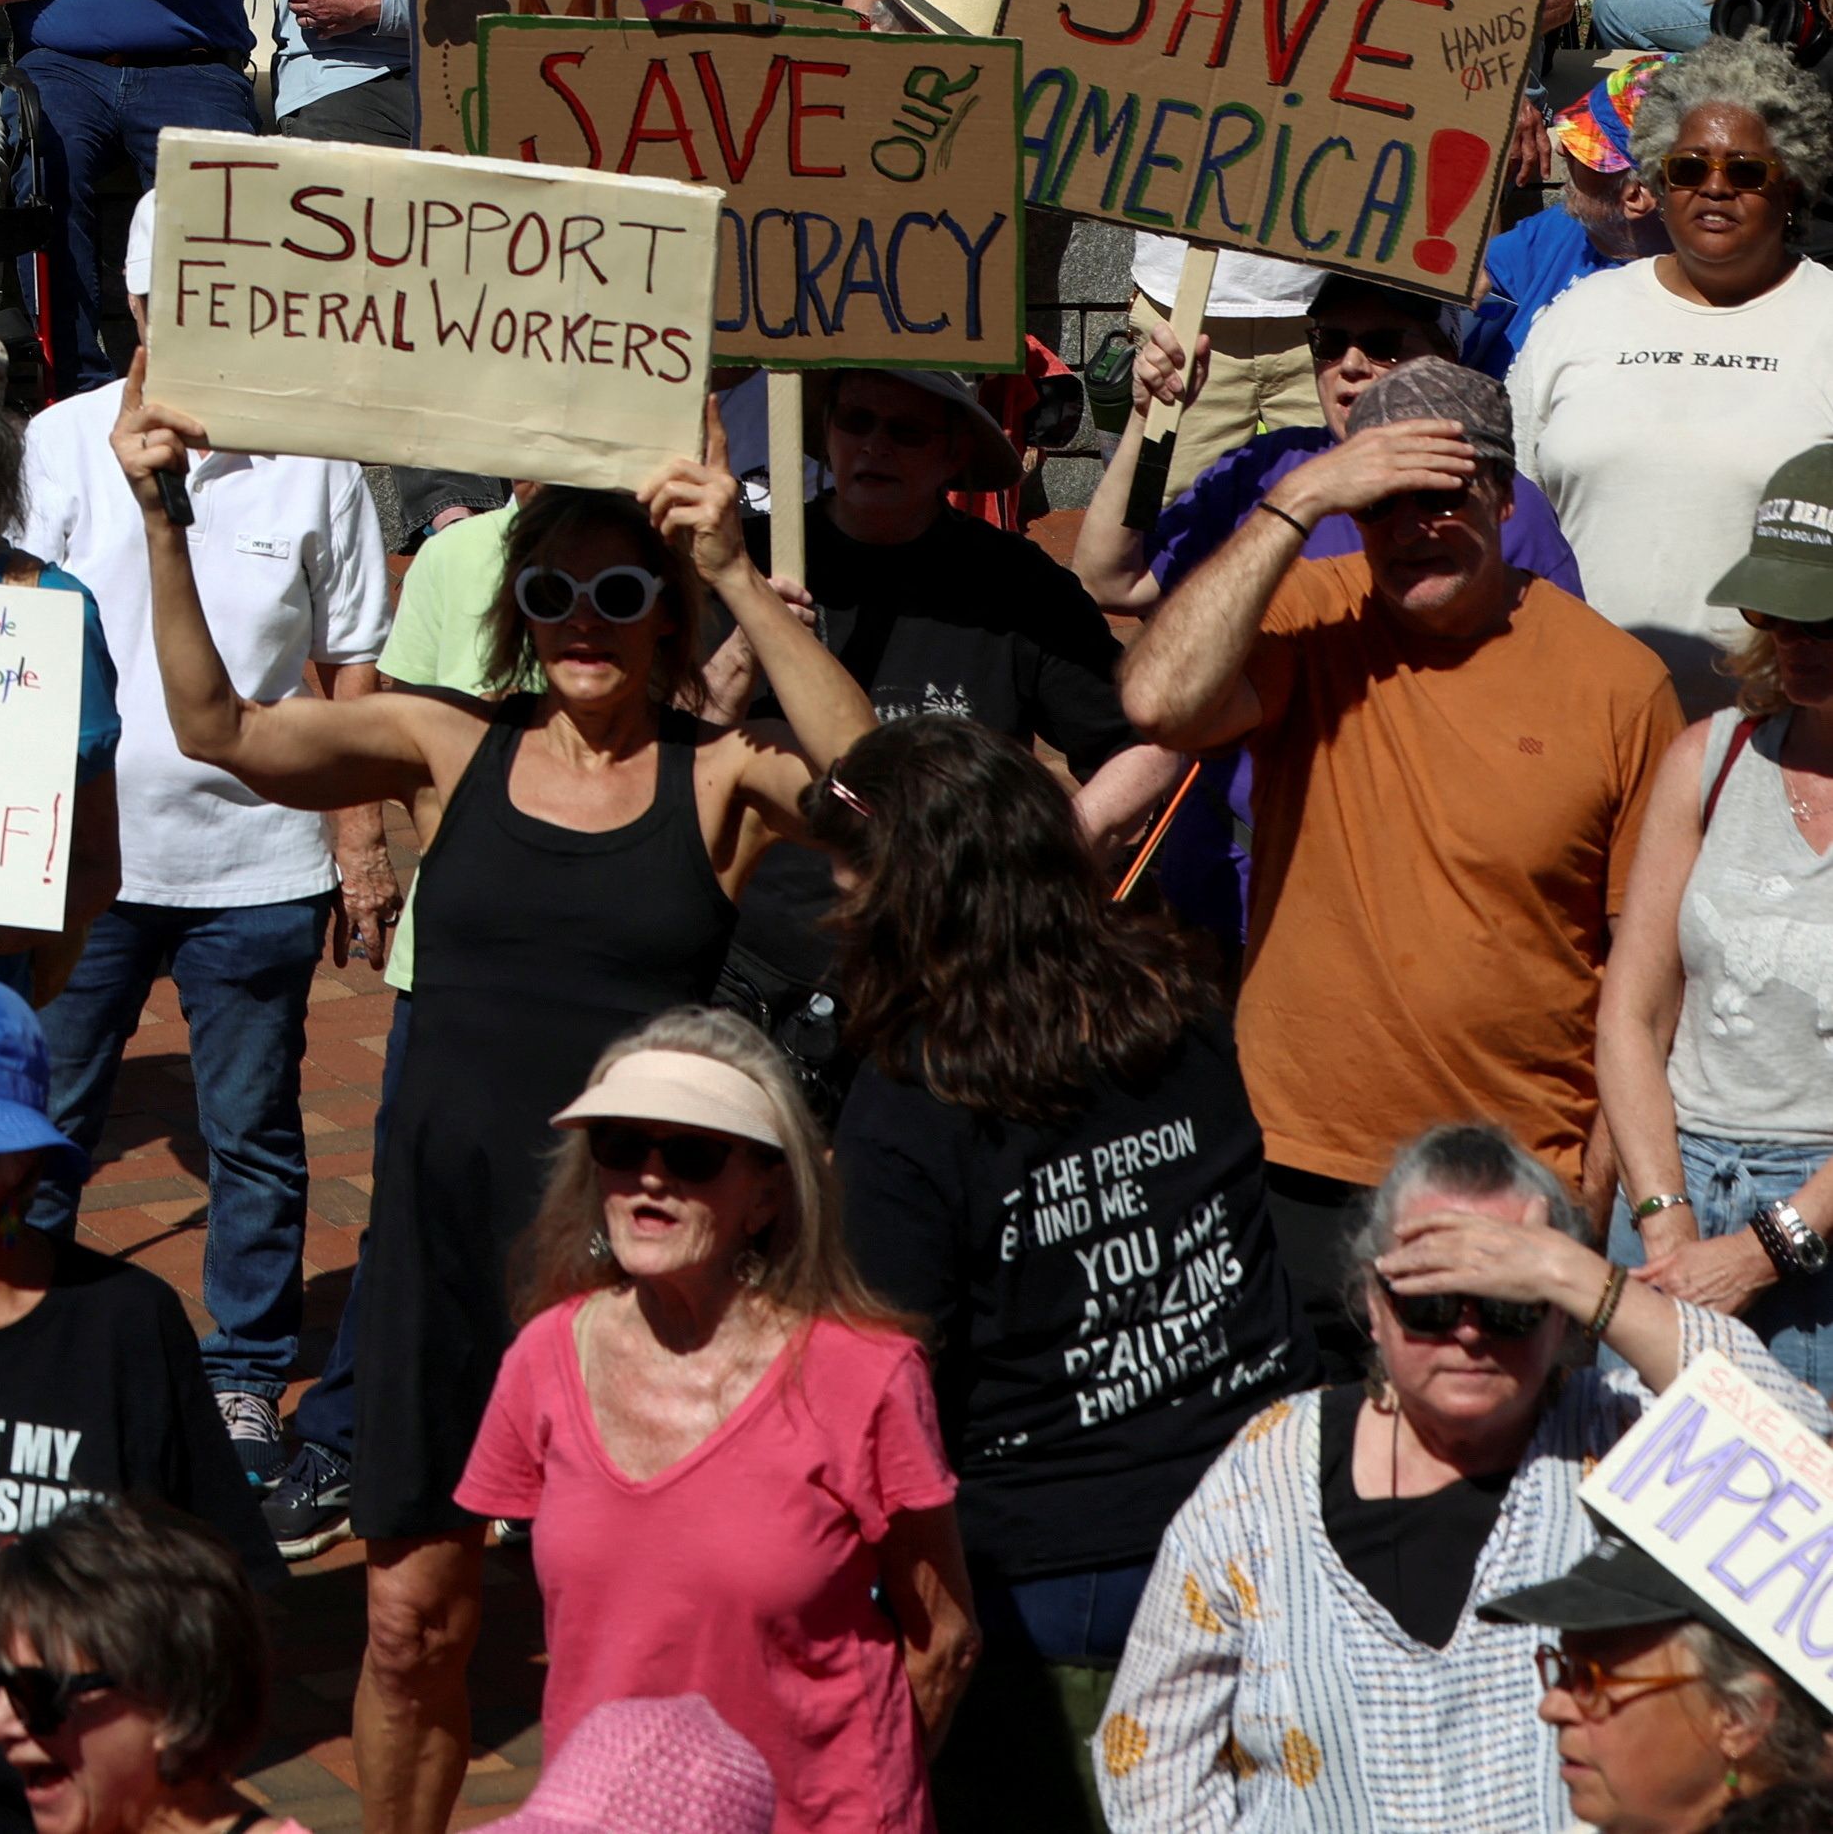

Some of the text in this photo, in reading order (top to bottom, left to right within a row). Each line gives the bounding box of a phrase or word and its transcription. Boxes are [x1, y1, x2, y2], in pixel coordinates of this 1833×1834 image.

[1441, 7, 1527, 71] HANDS
[1460, 53, 1518, 101] OFF
[520, 51, 981, 184] SAVE OUR
[185, 162, 686, 293] I SUPPORT
[177, 259, 693, 384] FEDERAL WORKERS
[1619, 350, 1780, 373] LOVE EARTH
